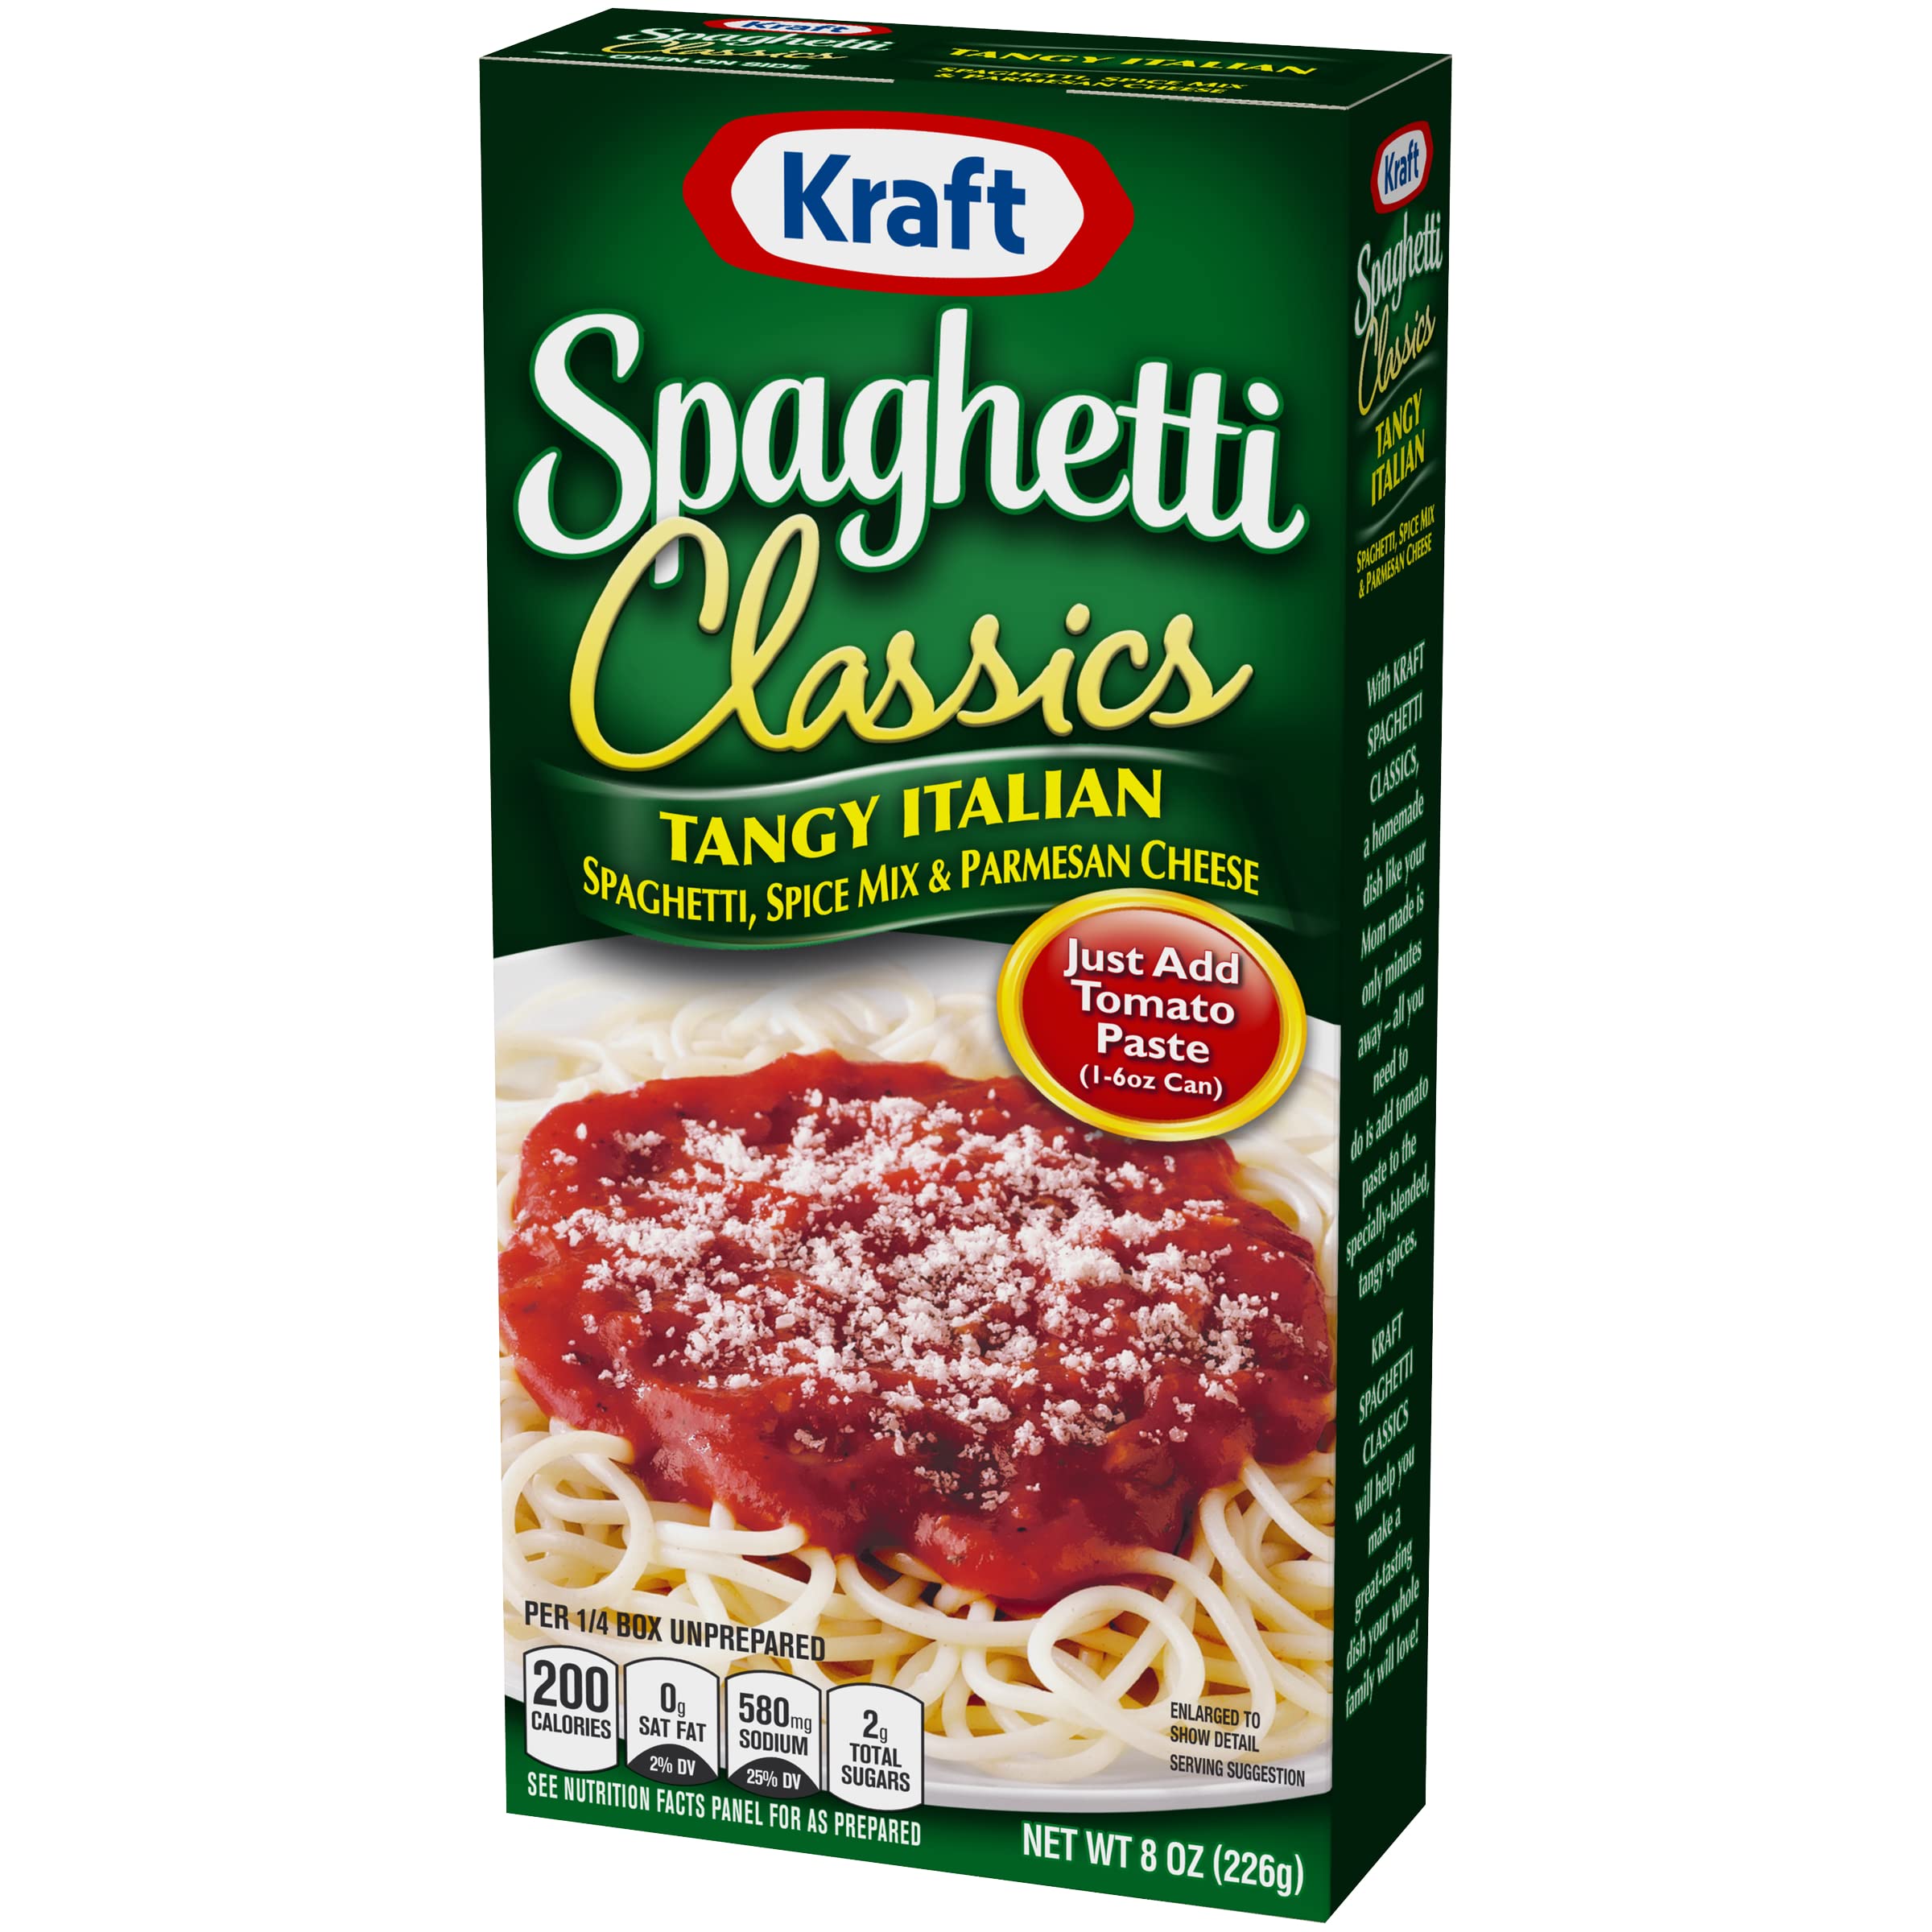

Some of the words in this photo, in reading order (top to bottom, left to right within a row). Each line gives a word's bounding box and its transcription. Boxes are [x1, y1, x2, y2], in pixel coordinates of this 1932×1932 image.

[601, 40, 848, 60] Classics
[616, 28, 894, 51] Spaghetti
[741, 20, 849, 33] Kraft
[609, 55, 688, 63] OPEN
[949, 48, 1116, 63] TANGY
[1121, 58, 1318, 75] ITALIAN
[1385, 138, 1419, 195] Kraft
[783, 151, 1026, 255] Kraft
[1354, 211, 1443, 337] Spaghetti
[1359, 303, 1435, 415] Classics
[517, 307, 1306, 584] Spaghetti
[1375, 388, 1422, 459] TANGY
[1371, 428, 1425, 507] ITALIAN
[1356, 530, 1397, 573] SPAGHETTI,
[1398, 514, 1419, 546] SPICE
[1421, 504, 1435, 527] MIX
[1359, 579, 1365, 599] &
[1366, 551, 1405, 594] PARMESAN
[1406, 532, 1432, 565] CHEESE
[570, 514, 1253, 770] Classics
[1367, 665, 1390, 707] With
[1393, 642, 1425, 686] KRAFT
[1368, 692, 1422, 757] SPAGHETTI
[1370, 745, 1419, 803] CLASSICS,
[659, 796, 881, 865] TANGY
[903, 768, 1162, 836] ITALIAN
[1364, 836, 1369, 858] a
[1373, 790, 1424, 852] homemade
[582, 855, 757, 931] SPAGHETTI,
[766, 881, 849, 922] SPICE
[857, 863, 918, 906] MIX
[928, 867, 952, 893] &
[961, 844, 1130, 889] PARMESAN
[1140, 840, 1260, 896] CHEESE
[1364, 868, 1382, 907] dish
[1385, 856, 1402, 890] like
[1405, 841, 1426, 886] your
[1360, 925, 1385, 960] Mom
[1389, 893, 1414, 935] made
[1417, 886, 1423, 913] is
[1063, 938, 1144, 977] Just
[1152, 947, 1239, 985] Add
[1362, 968, 1382, 1004] only
[1385, 940, 1422, 987] minutes
[1071, 979, 1235, 1024] Tomato
[1358, 1021, 1382, 1059] away
[1393, 993, 1405, 1028] all
[1407, 986, 1424, 1027] you
[1097, 1022, 1209, 1063] Paste
[1373, 1048, 1396, 1094] need
[1398, 1046, 1408, 1071] to
[1080, 1064, 1156, 1090] (1-6oz
[1164, 1072, 1224, 1101] Can)
[1351, 1129, 1363, 1161] do
[1366, 1120, 1373, 1148] is
[1376, 1100, 1393, 1140] add
[1396, 1077, 1428, 1121] tomato
[1362, 1161, 1387, 1209] paste
[1389, 1149, 1399, 1174] to
[1402, 1133, 1416, 1164] the
[1346, 1162, 1430, 1268] specially-blended,
[1359, 1257, 1385, 1298] tangy
[1387, 1231, 1417, 1278] spices.
[1372, 1311, 1403, 1364] KRAFT
[1359, 1348, 1413, 1423] SPAGHETTI
[1363, 1399, 1409, 1465] CLASSICS
[1356, 1480, 1372, 1521] will
[1376, 1461, 1395, 1500] help
[1397, 1446, 1414, 1488] you
[1368, 1513, 1393, 1555] make
[1395, 1507, 1401, 1527] a
[1355, 1539, 1413, 1624] great-tasting
[525, 1600, 568, 1630] PER
[576, 1608, 609, 1635] 1/4
[616, 1613, 663, 1641] BOX
[671, 1618, 825, 1662] UNPREPARED
[1347, 1629, 1365, 1670] dish
[1368, 1611, 1389, 1656] your
[1392, 1575, 1419, 1622] whole
[533, 1659, 609, 1714] 200
[660, 1682, 686, 1718] 0g
[1346, 1668, 1375, 1719] family
[1377, 1642, 1394, 1684] will
[1397, 1618, 1419, 1666] love!
[531, 1711, 612, 1740] CALORIES
[638, 1715, 672, 1737] SAT
[677, 1720, 707, 1743] FAT
[739, 1729, 808, 1756] SODIUM
[862, 1709, 888, 1743] 2g
[1170, 1702, 1239, 1726] ENLARGED
[1244, 1711, 1261, 1729] TO
[1170, 1726, 1210, 1746] SHOW
[1214, 1732, 1259, 1752] DETAIL
[650, 1756, 672, 1773] 2%
[677, 1758, 696, 1777] DV
[746, 1769, 778, 1787] 25%
[782, 1773, 801, 1790] DV
[841, 1765, 910, 1793] SUGARS
[849, 1743, 902, 1769] TOTAL
[1170, 1755, 1223, 1777] SERVING
[1228, 1763, 1305, 1787] SUGGESTION
[527, 1773, 558, 1798] SEE
[564, 1777, 650, 1810] NUTRITION
[657, 1789, 705, 1818] FACTS
[711, 1795, 763, 1826] PANEL
[770, 1803, 801, 1831] FOR
[807, 1809, 828, 1835] AS
[834, 1813, 921, 1846] PREPARED
[1023, 1823, 1077, 1861] NET
[1086, 1831, 1132, 1868] WT
[1141, 1839, 1156, 1872] 8
[1166, 1842, 1204, 1879] OZ
[1213, 1844, 1304, 1897] (226g)
